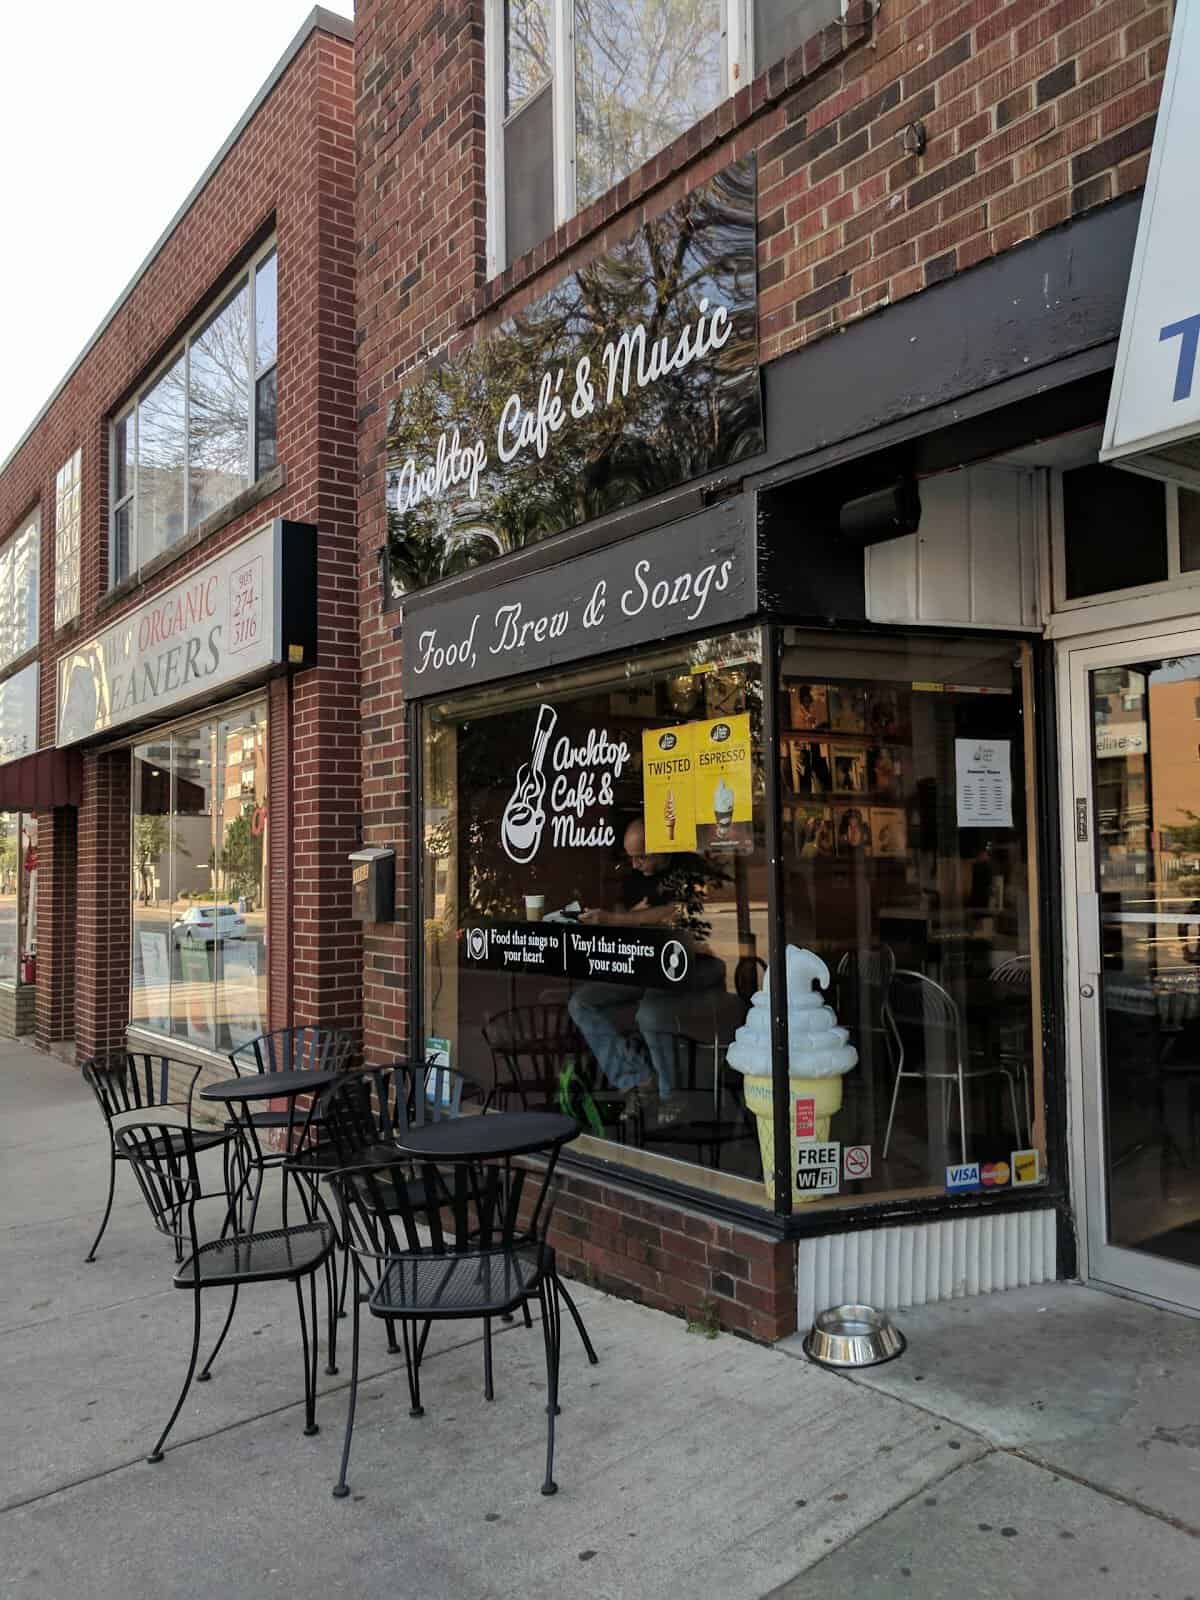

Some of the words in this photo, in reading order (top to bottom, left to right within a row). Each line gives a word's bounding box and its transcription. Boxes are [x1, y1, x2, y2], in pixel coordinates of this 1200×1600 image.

[398, 429, 488, 514] Archtop
[497, 368, 567, 463] Café
[571, 356, 595, 418] &
[602, 298, 733, 404] Music
[137, 575, 219, 652] ORGANIC
[414, 614, 480, 674] Food,
[489, 602, 570, 654] Brew
[582, 580, 607, 627] &
[621, 559, 733, 620] Songs
[110, 625, 223, 713] EANERS
[552, 728, 631, 777] Archtop
[648, 757, 691, 776] TWISTED
[699, 748, 746, 766] ESPRESSO
[551, 771, 596, 817] Café
[598, 773, 614, 806] &
[551, 816, 616, 848] Music
[491, 928, 511, 945] Food
[512, 929, 527, 946] that
[528, 931, 548, 949] sings
[549, 934, 559, 949] to
[571, 934, 596, 957] Vinyl
[597, 937, 616, 955] that
[618, 939, 655, 963] inspires
[503, 950, 522, 965] your
[522, 948, 545, 964] heart.
[589, 960, 610, 975] your
[611, 958, 635, 974] soul.
[798, 1148, 836, 1165] FREE
[950, 1167, 978, 1183] VISA
